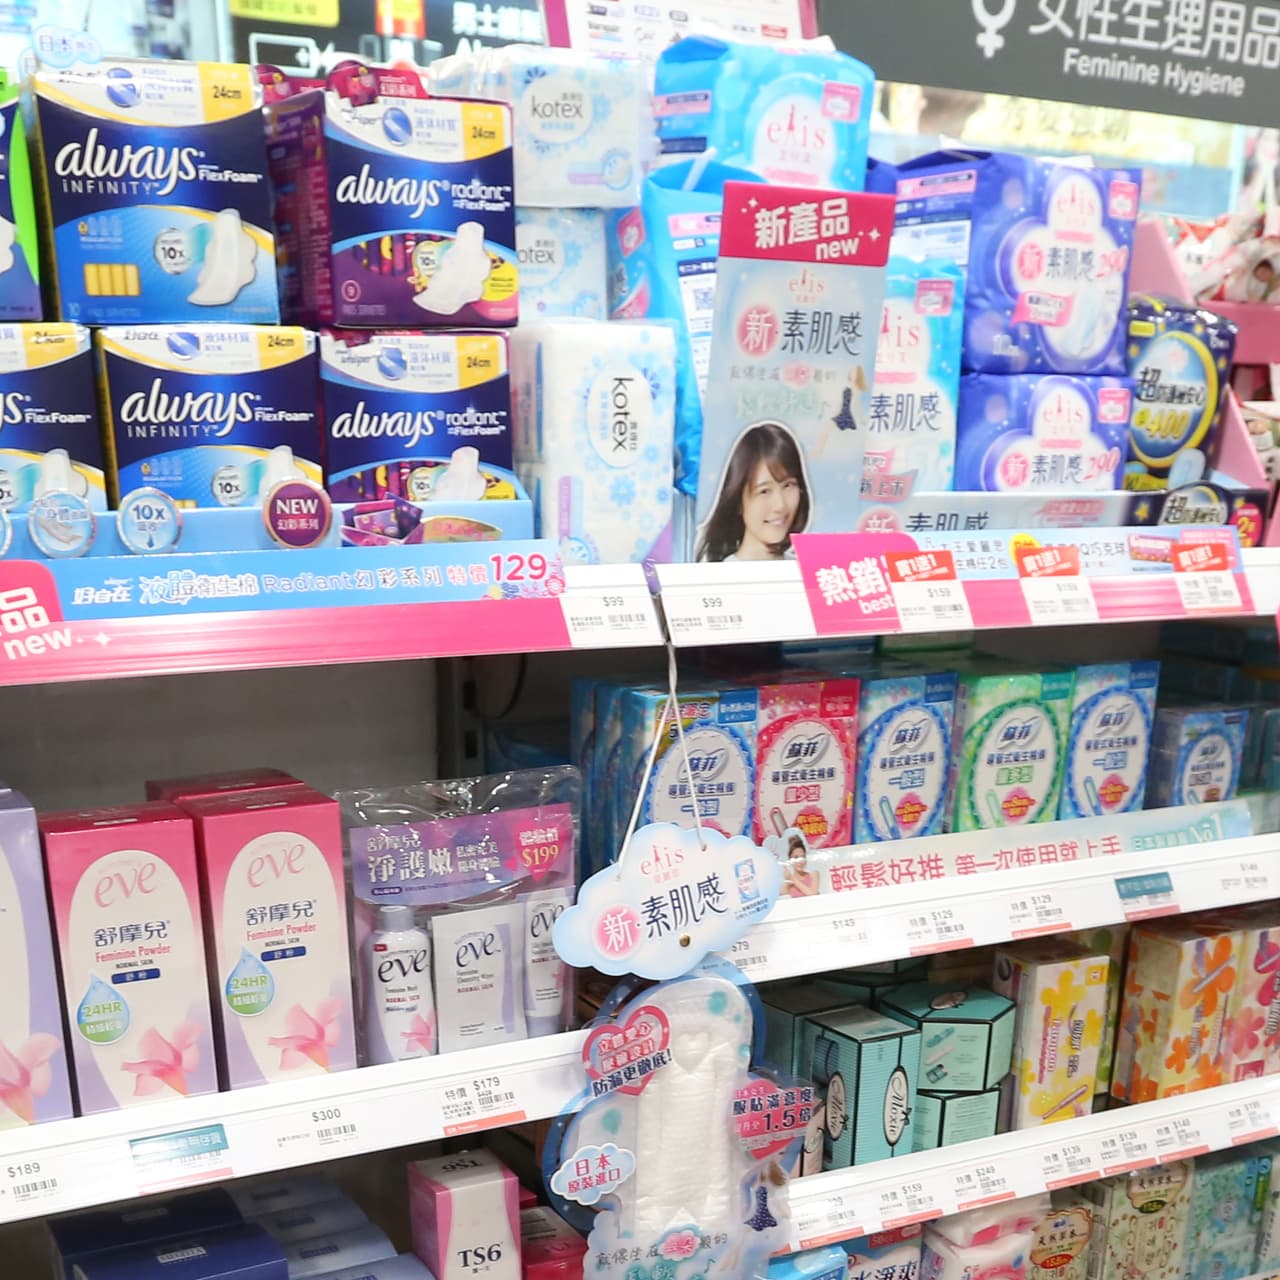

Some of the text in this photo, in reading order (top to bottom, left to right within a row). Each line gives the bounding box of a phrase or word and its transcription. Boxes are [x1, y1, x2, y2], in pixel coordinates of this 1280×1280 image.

[1062, 48, 1245, 97] Feminine Hygiene
[530, 97, 584, 119] kotex
[56, 128, 199, 195] always
[336, 164, 441, 217] always
[755, 198, 851, 249] 新產品
[815, 236, 860, 261] new
[781, 310, 864, 356] 素肌感
[120, 376, 253, 441] always
[612, 376, 629, 453] kotex
[276, 498, 319, 516] NEW
[490, 553, 547, 582] 129
[602, 596, 625, 609] $99
[701, 596, 723, 610] $99
[3, 628, 73, 661] new
[522, 845, 559, 867] $199
[639, 843, 685, 877] elis
[246, 900, 315, 926] 舒摩兒
[640, 875, 728, 941] 素肌感
[95, 921, 169, 947] 舒摩兒
[232, 975, 268, 990] 24HR
[83, 1001, 121, 1018] 24HR
[312, 1107, 342, 1123] $300
[7, 1162, 41, 1178] $189
[575, 1154, 610, 1177] 日本
[568, 1166, 622, 1195] 原裝進口
[458, 1244, 499, 1268] TS6
